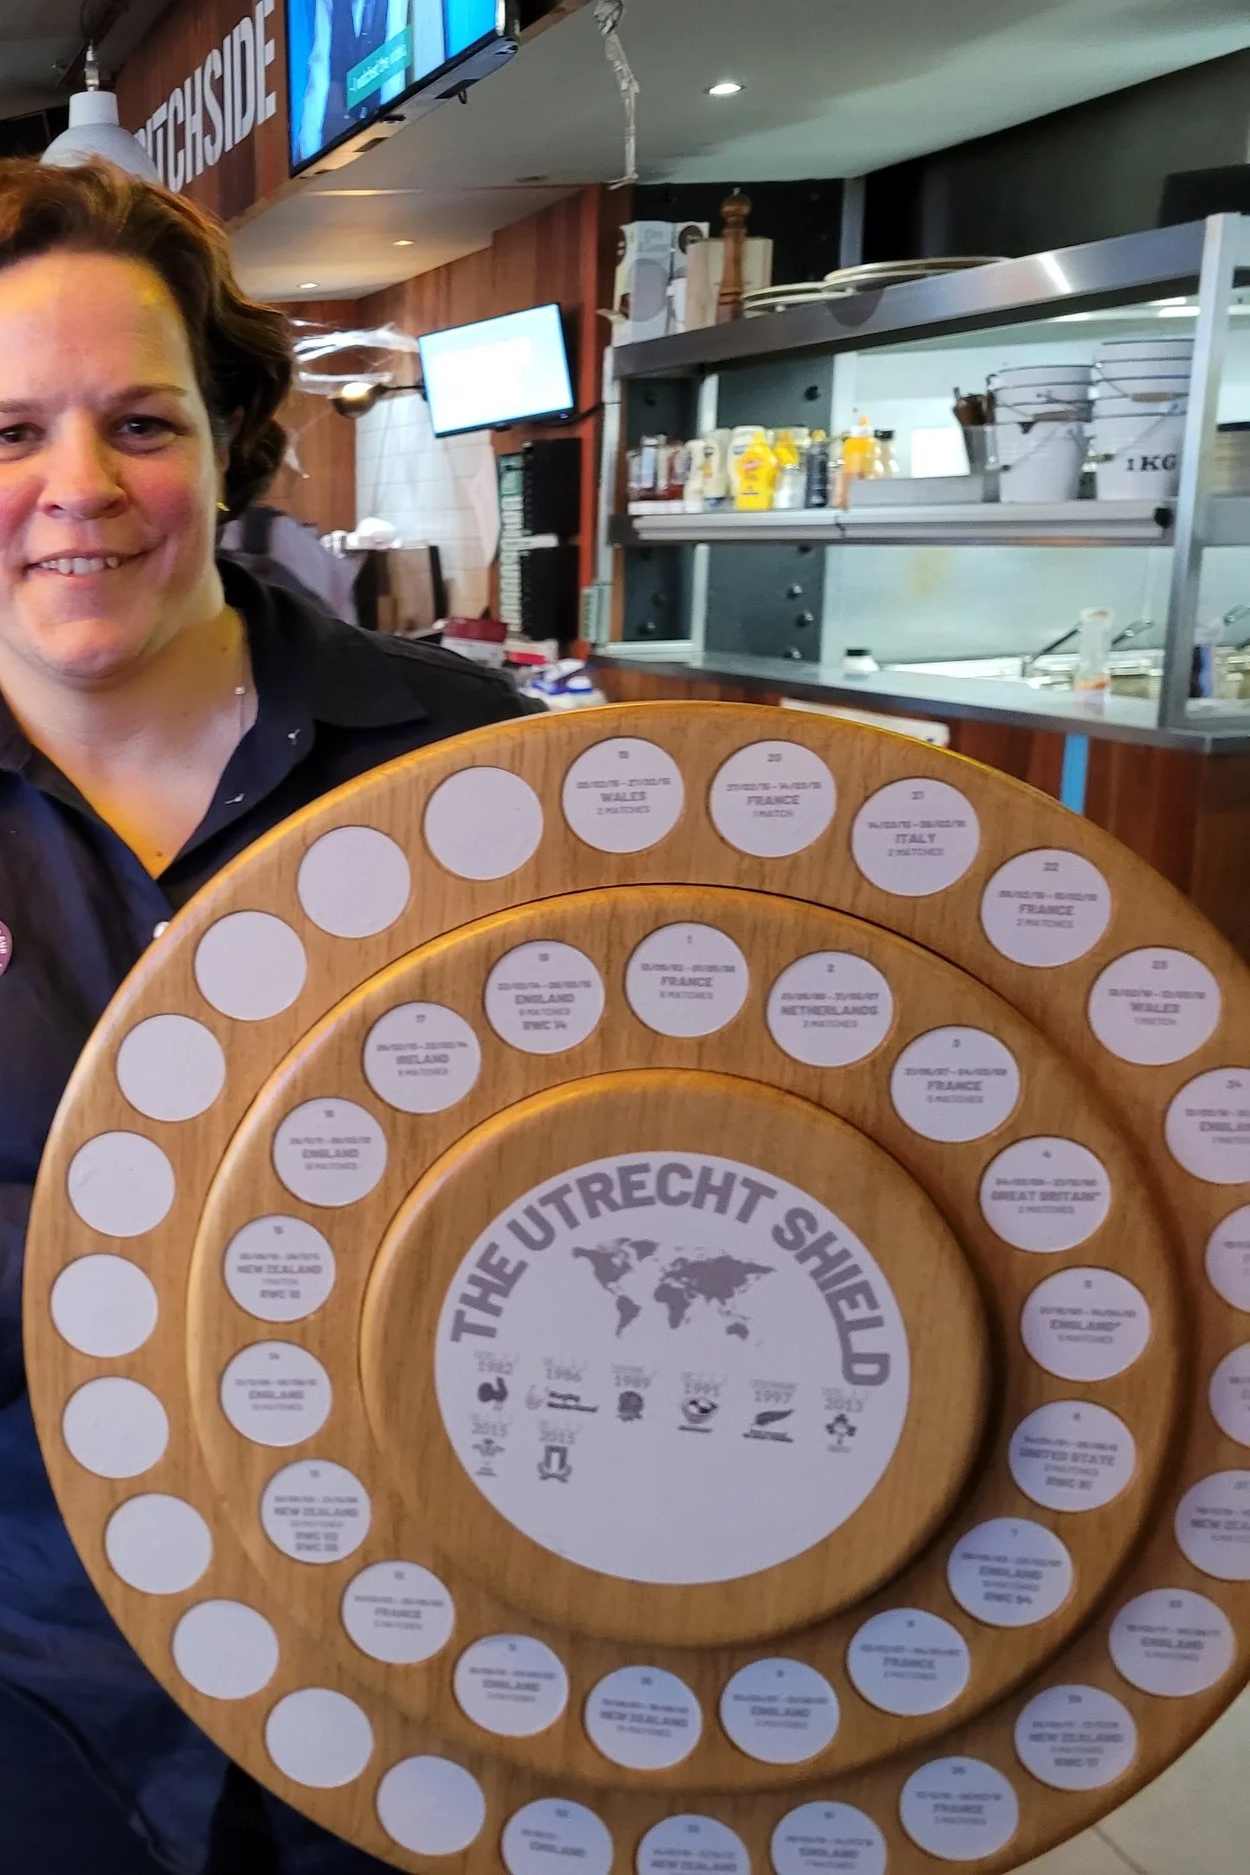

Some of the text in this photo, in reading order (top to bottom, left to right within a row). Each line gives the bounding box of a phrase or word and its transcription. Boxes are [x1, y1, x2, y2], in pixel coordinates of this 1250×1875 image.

[134, 0, 277, 194] ITCHSIDE
[601, 791, 646, 802] WALES
[747, 795, 799, 805] FRANCE
[896, 833, 936, 843] ITALY
[1018, 904, 1074, 915] FRANCE
[661, 976, 713, 987] FRANCE
[515, 993, 574, 1004] ENGLAND
[781, 1005, 878, 1015] NETHERLANDS
[396, 1054, 449, 1065] IRELAND
[928, 1080, 982, 1090] FRANCE
[450, 1162, 890, 1387] THE UTRECHT SHIELD
